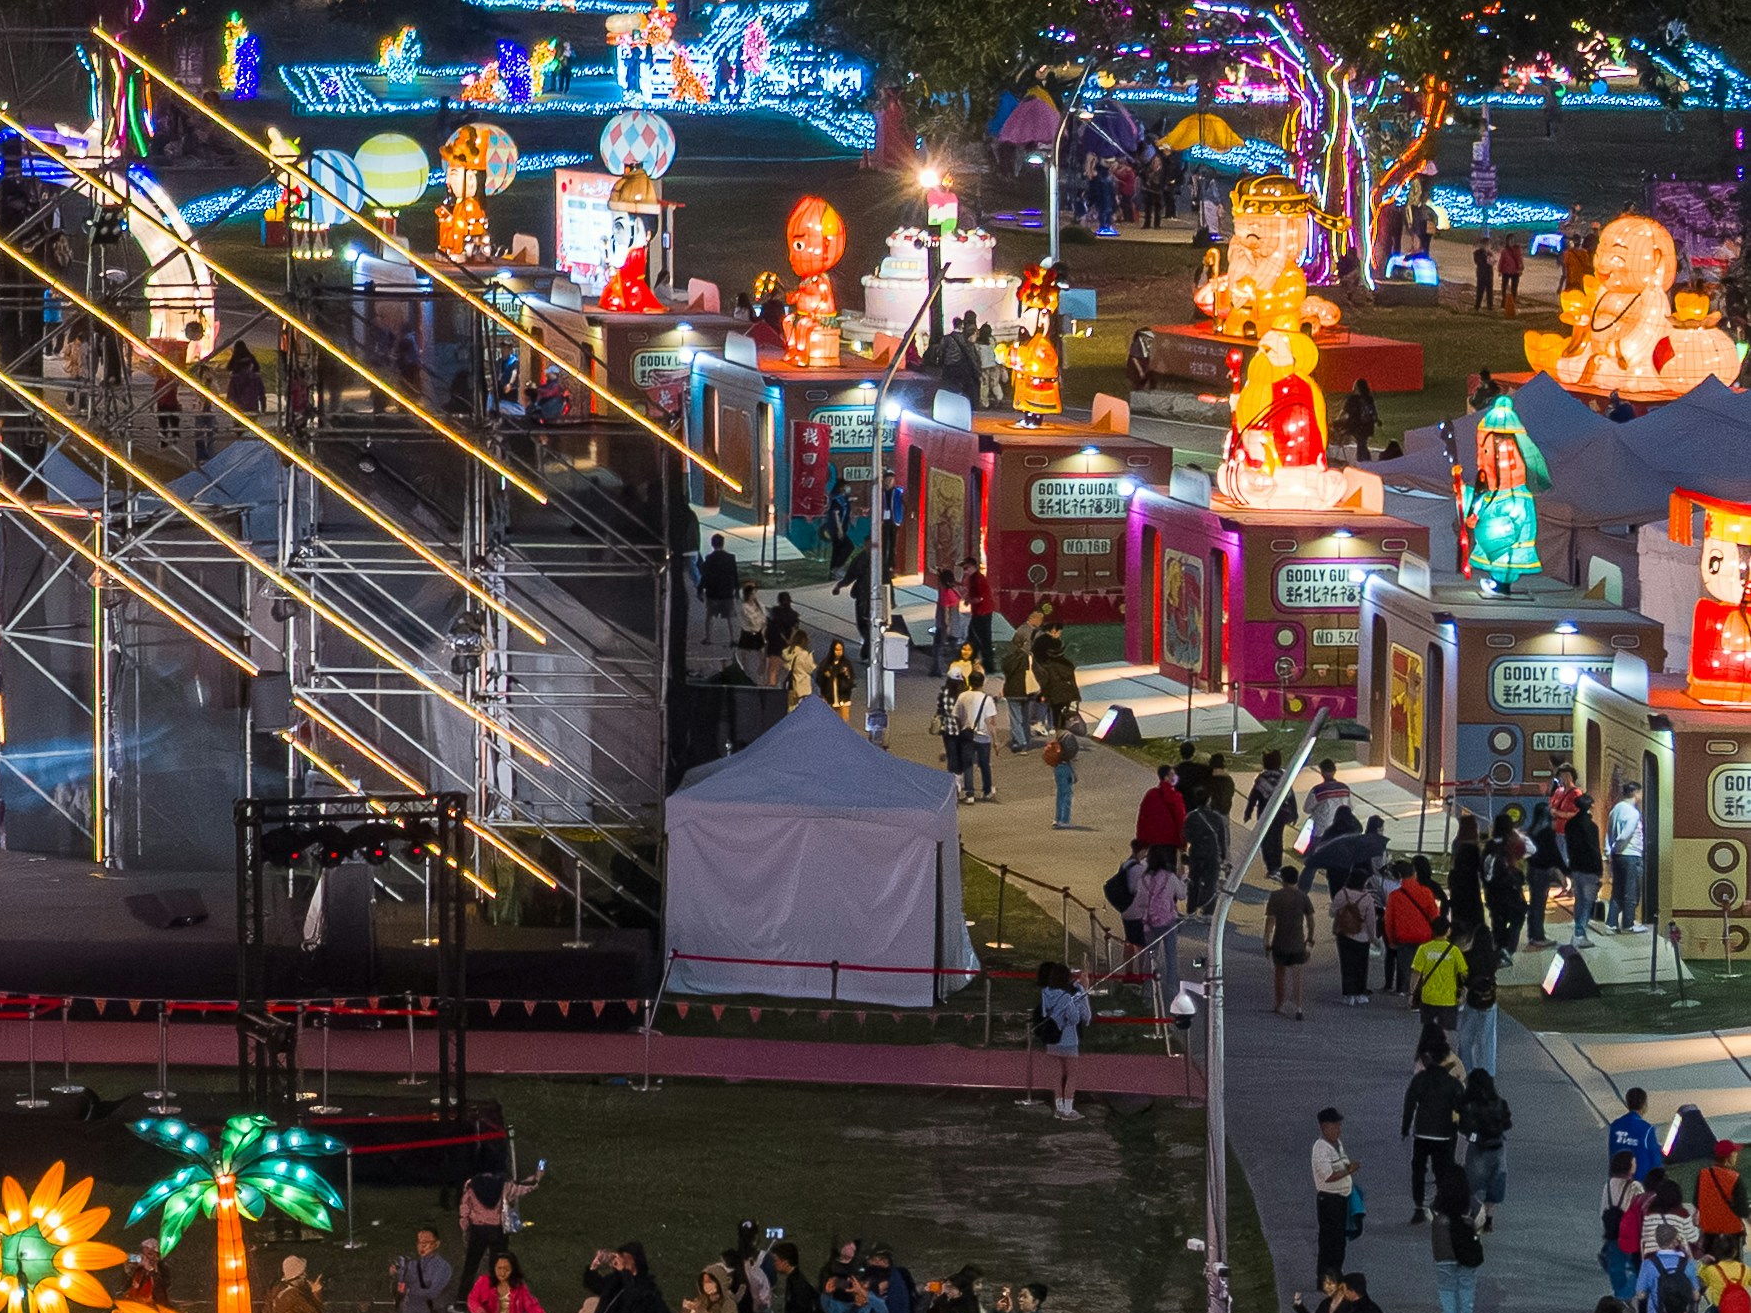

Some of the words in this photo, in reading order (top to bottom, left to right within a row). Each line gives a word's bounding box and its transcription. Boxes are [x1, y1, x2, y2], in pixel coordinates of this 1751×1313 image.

[640, 355, 671, 367] GODLY
[819, 414, 853, 427] GODLY
[1038, 483, 1074, 495] GODLY
[1038, 498, 1127, 514] 新北祈福列
[1286, 569, 1326, 582] GODLY
[1503, 667, 1547, 681] GODLY
